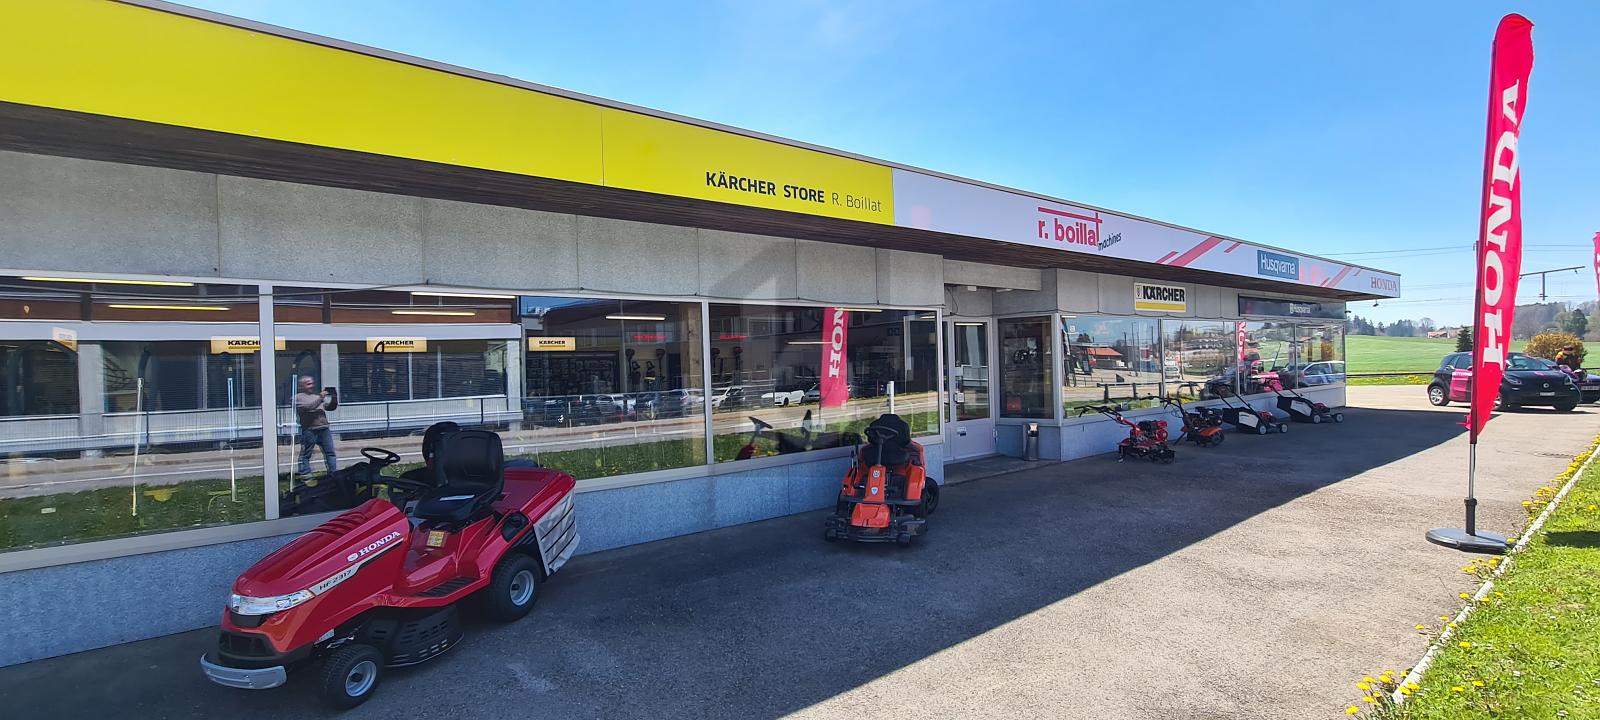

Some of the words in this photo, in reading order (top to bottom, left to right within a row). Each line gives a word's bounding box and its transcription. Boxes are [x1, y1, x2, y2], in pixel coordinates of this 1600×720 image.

[705, 171, 777, 196] KÄRCHER
[783, 184, 825, 204] STORE
[831, 192, 842, 206] R.
[846, 195, 882, 213] Boillat
[1038, 220, 1049, 240] r.
[1054, 212, 1101, 246] boillat
[1482, 79, 1520, 371] HONDA
[1098, 232, 1122, 252] machines
[1260, 253, 1296, 275] Husqvarna
[1142, 285, 1185, 302] KÄRCHER
[1370, 276, 1398, 292] HONDA
[359, 531, 401, 557] HONDA
[319, 580, 332, 590] HF
[333, 569, 352, 584] 2317
